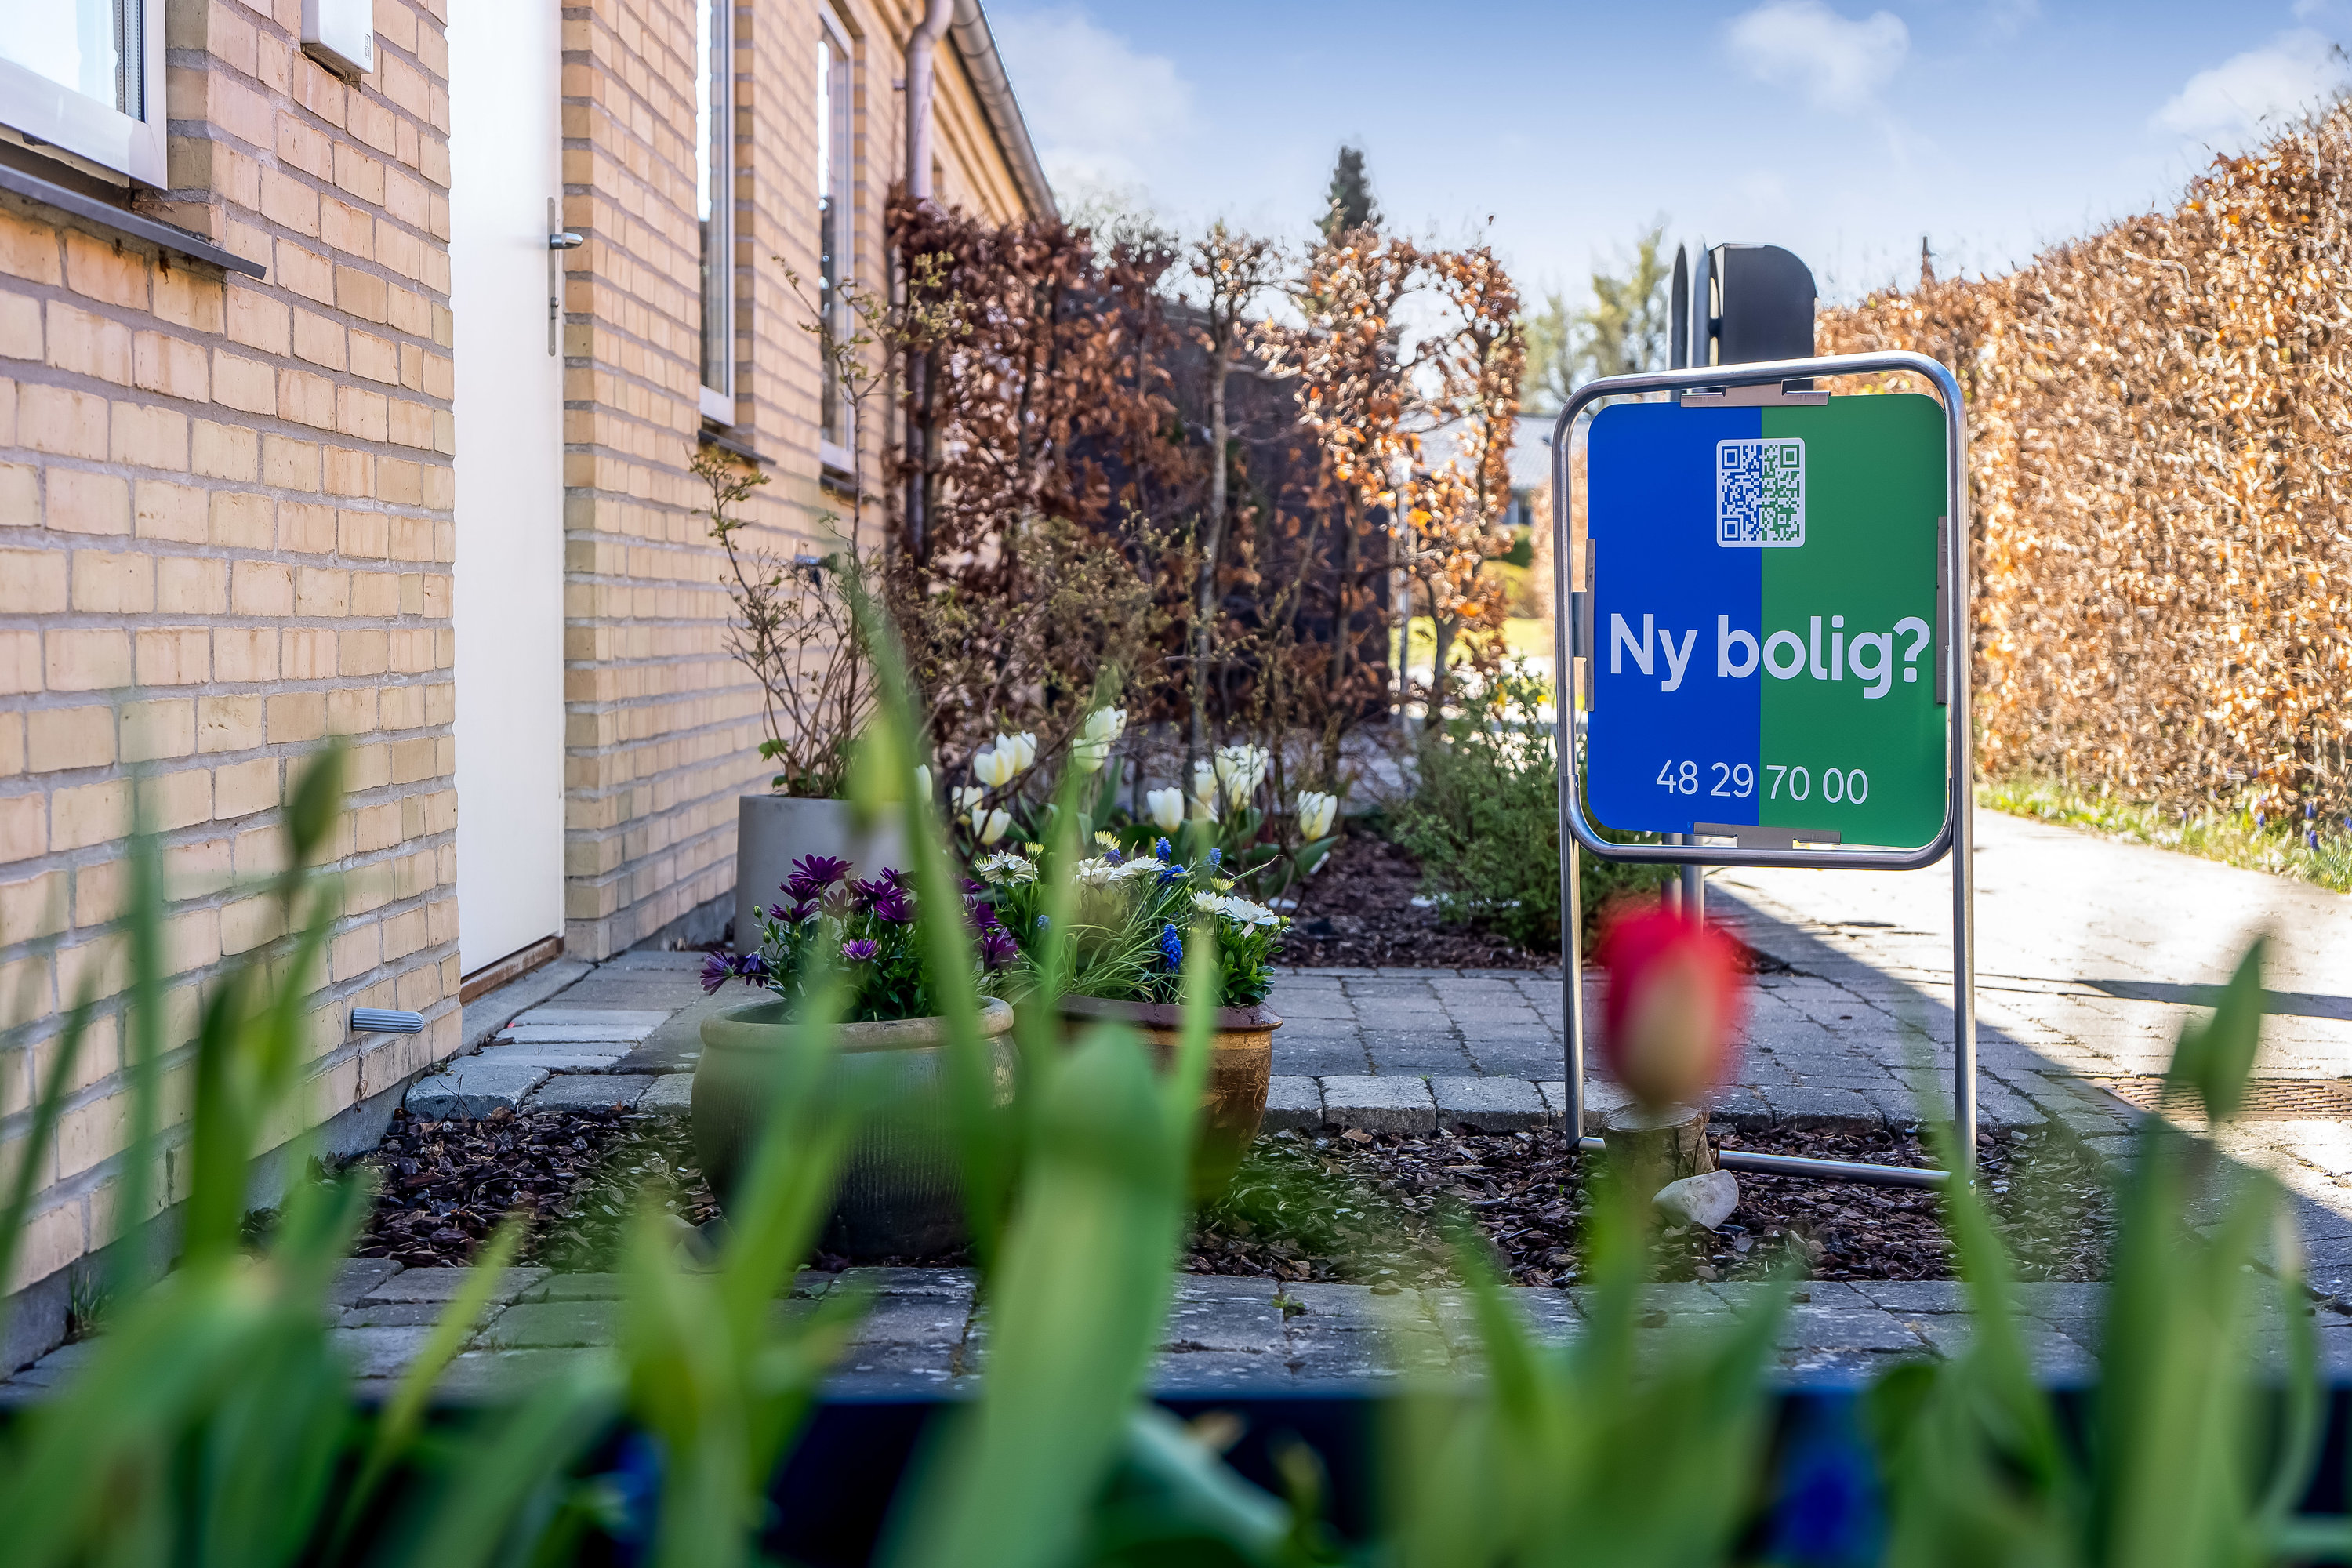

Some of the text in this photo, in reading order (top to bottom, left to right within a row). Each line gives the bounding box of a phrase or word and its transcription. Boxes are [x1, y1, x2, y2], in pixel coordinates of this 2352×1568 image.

[1610, 613, 1931, 699] Ny bolig?
[1656, 760, 1868, 804] 48 29 70 00
